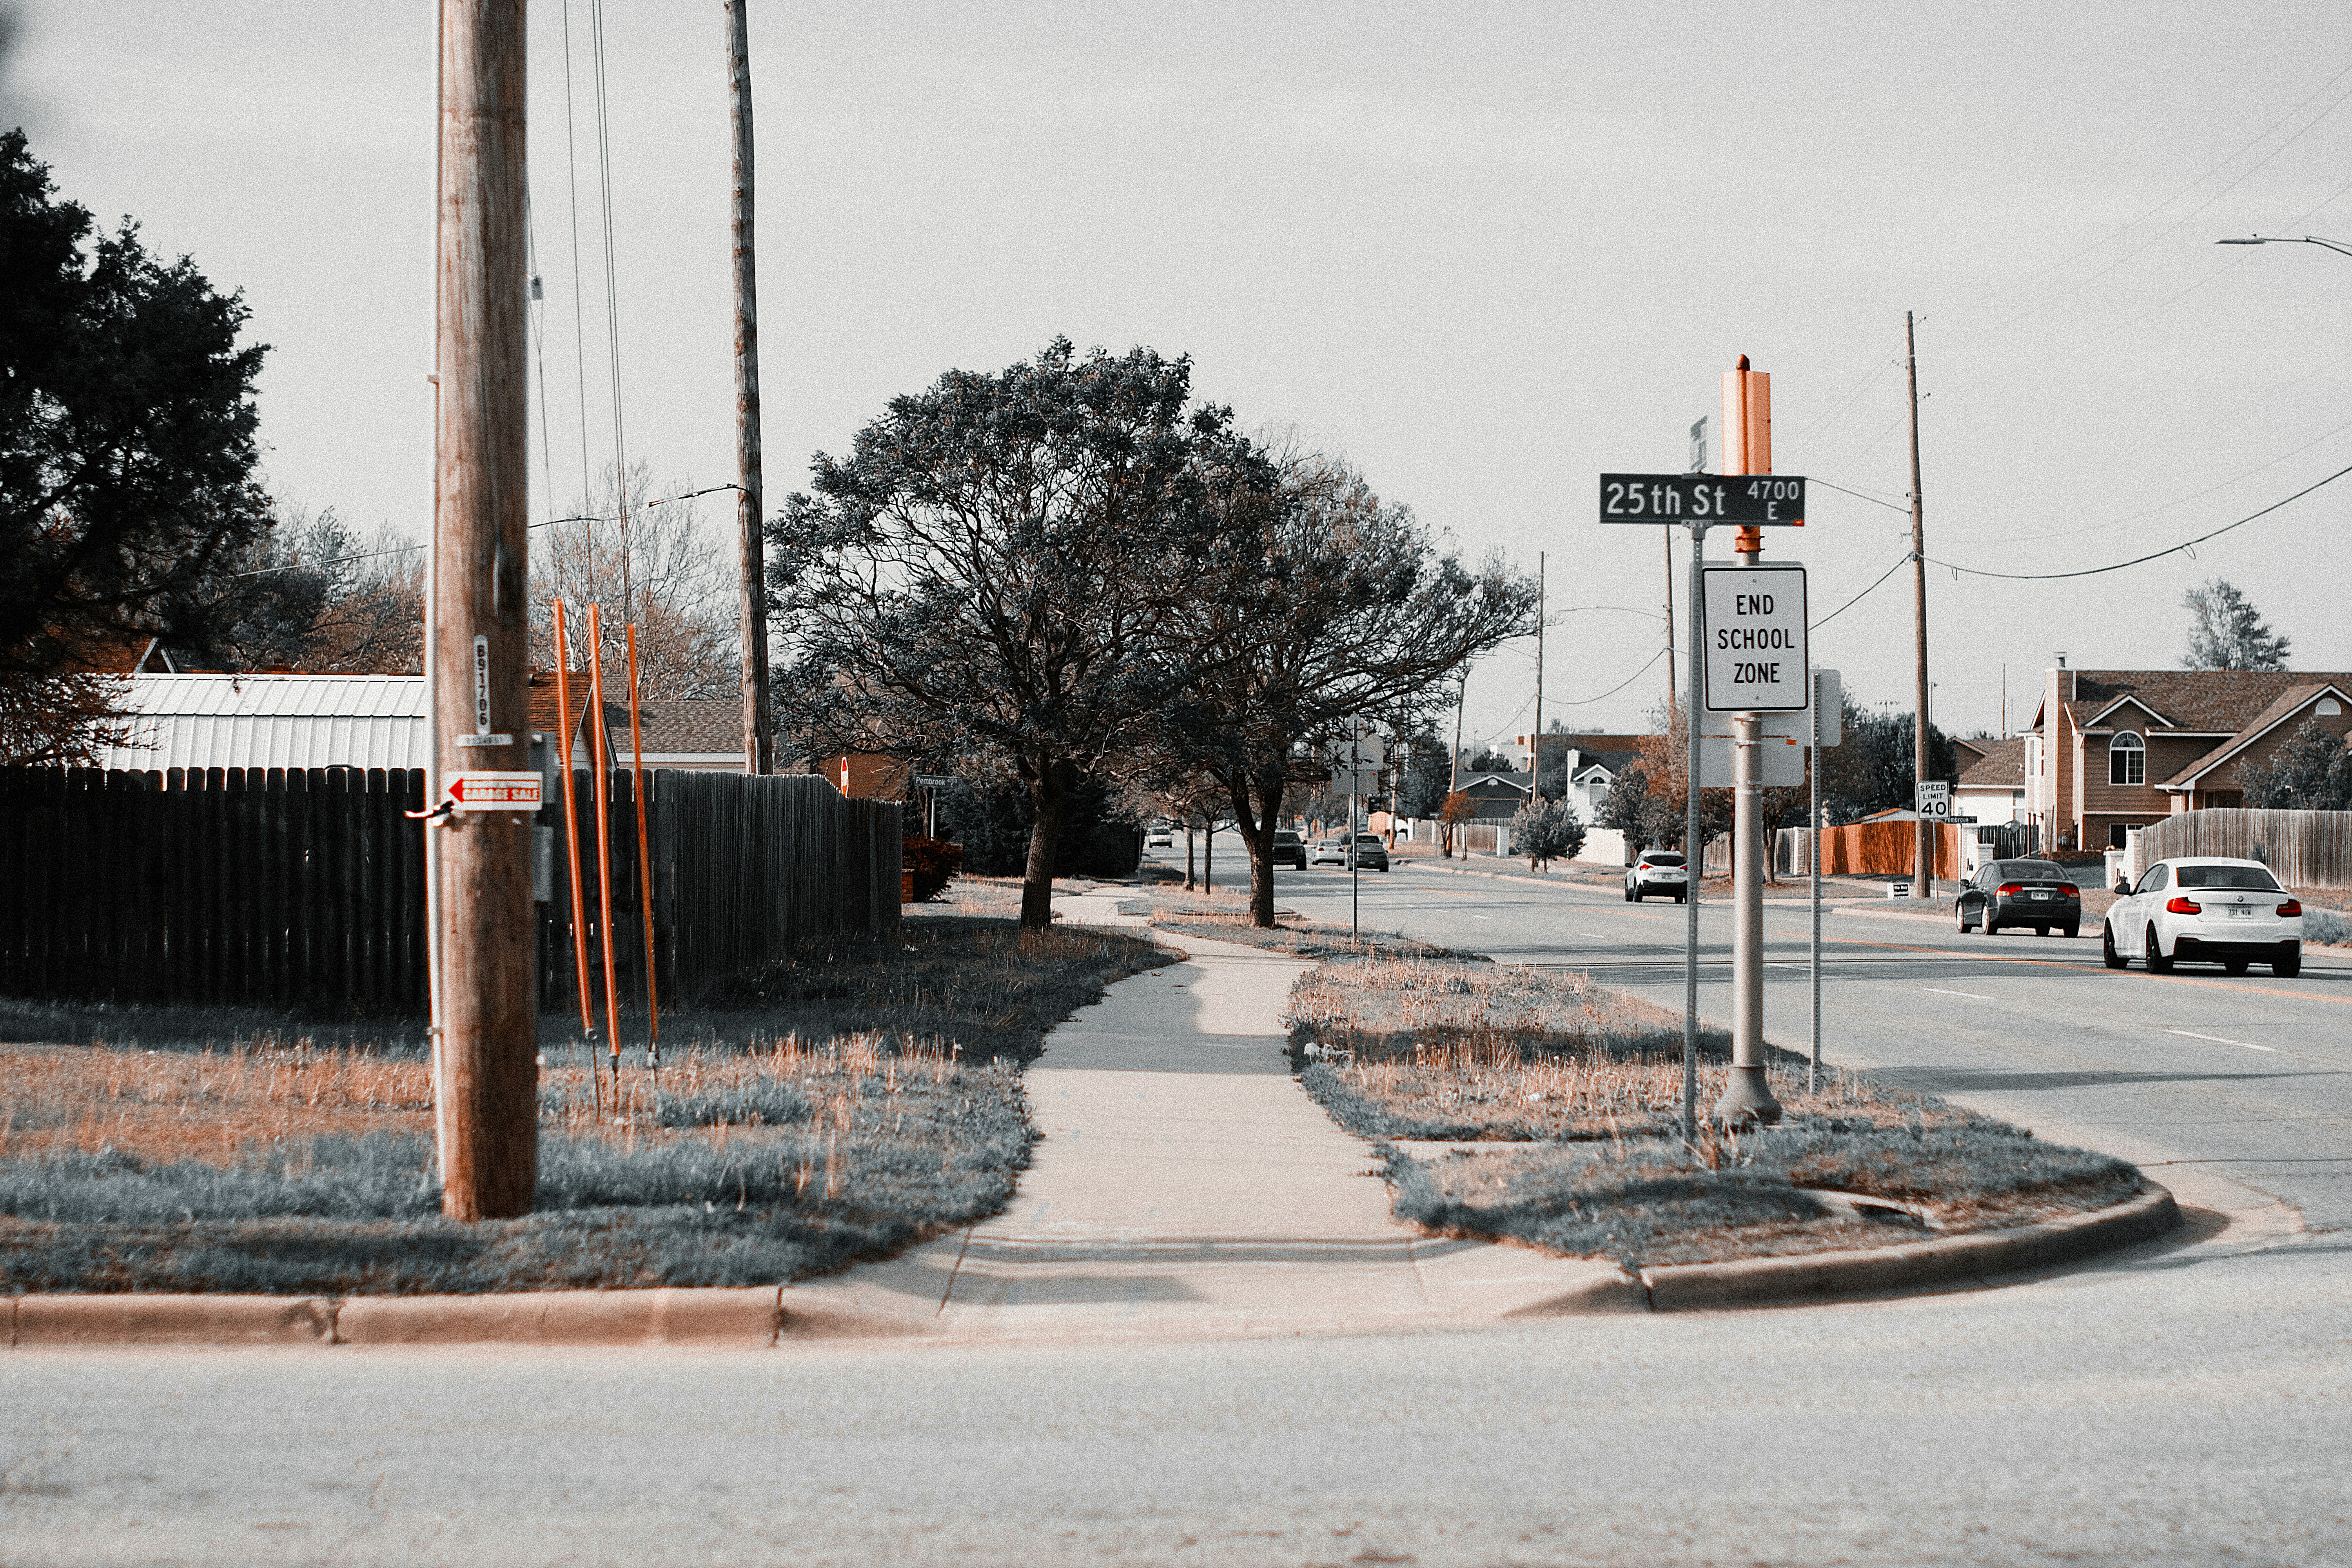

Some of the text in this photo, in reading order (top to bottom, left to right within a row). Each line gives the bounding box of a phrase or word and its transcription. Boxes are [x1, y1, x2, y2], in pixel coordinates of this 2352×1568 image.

[1607, 481, 1799, 515] 25th St 4700
[1767, 501, 1778, 520] E
[1736, 594, 1774, 615] END
[1717, 628, 1795, 650] SCHOOL
[1734, 662, 1780, 684] ZONE
[916, 777, 946, 786] Pembrook
[463, 789, 537, 800] GARAGE SALE
[1921, 801, 1947, 816] 40
